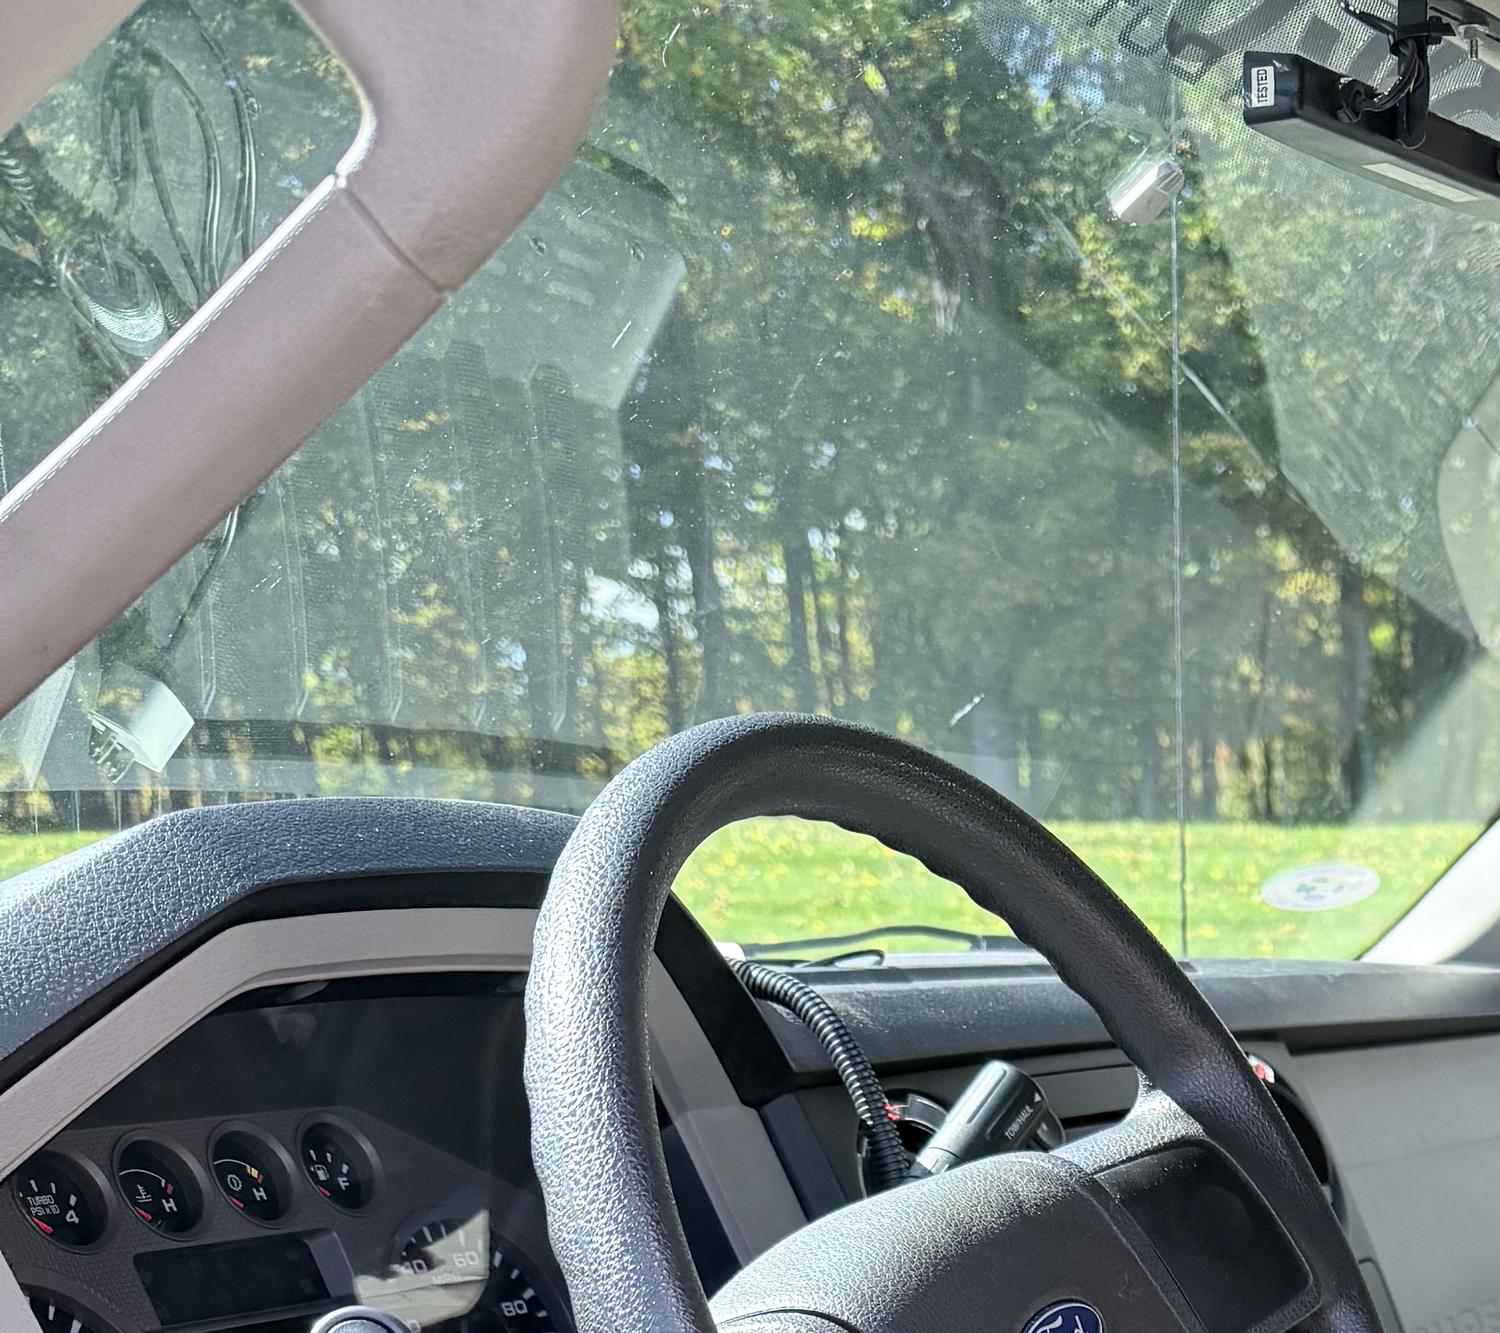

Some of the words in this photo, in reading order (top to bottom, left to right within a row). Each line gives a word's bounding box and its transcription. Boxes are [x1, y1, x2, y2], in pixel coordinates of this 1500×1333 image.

[1257, 69, 1268, 104] TESTED
[1004, 1104, 1034, 1140] TOW/HAUL
[337, 1176, 350, 1191] F
[26, 1194, 55, 1206] TURBO
[252, 1187, 268, 1201] H
[30, 1205, 46, 1216] PSI
[162, 1198, 178, 1212] H
[65, 1209, 80, 1224] 4
[452, 1251, 480, 1267] 60
[501, 1299, 528, 1317] 80
